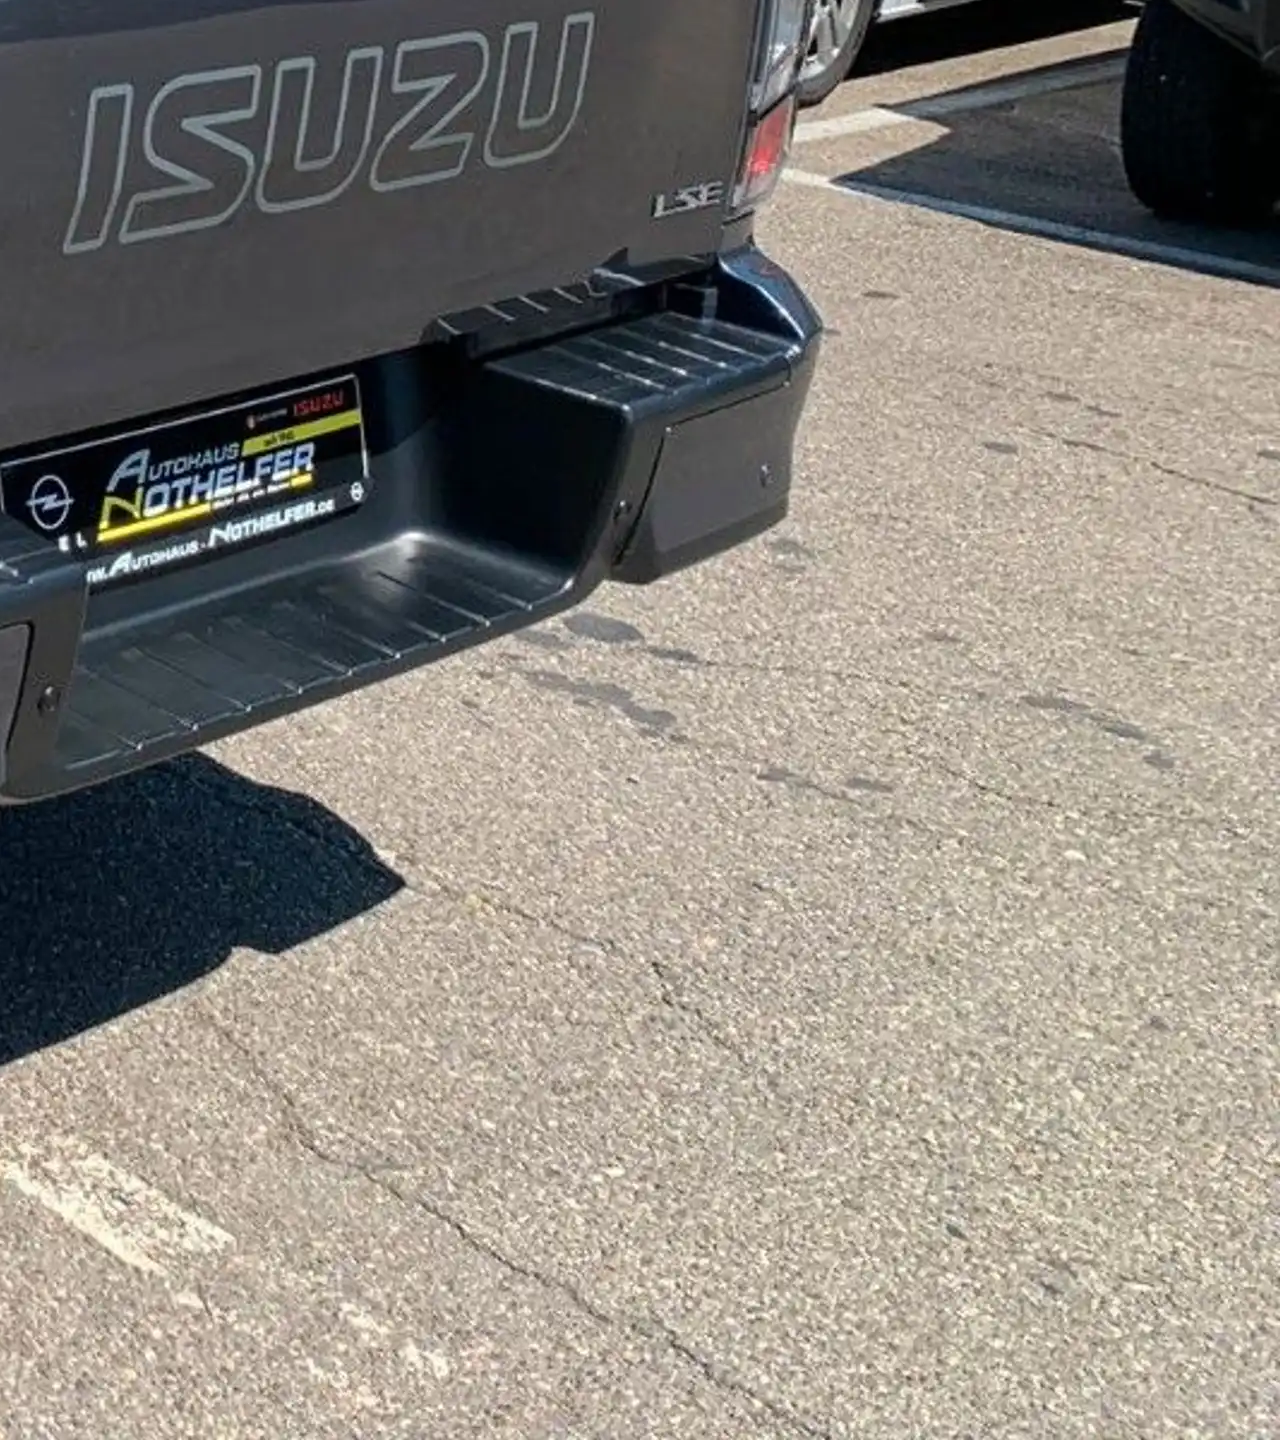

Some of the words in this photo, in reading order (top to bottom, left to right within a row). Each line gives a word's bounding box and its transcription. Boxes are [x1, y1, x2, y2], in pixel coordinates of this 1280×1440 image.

[62, 12, 595, 255] ISUZU
[652, 180, 724, 217] LSE
[293, 390, 344, 418] ISUZU
[97, 443, 316, 531] NOTHELFER
[106, 441, 240, 493] AUTOHAUS
